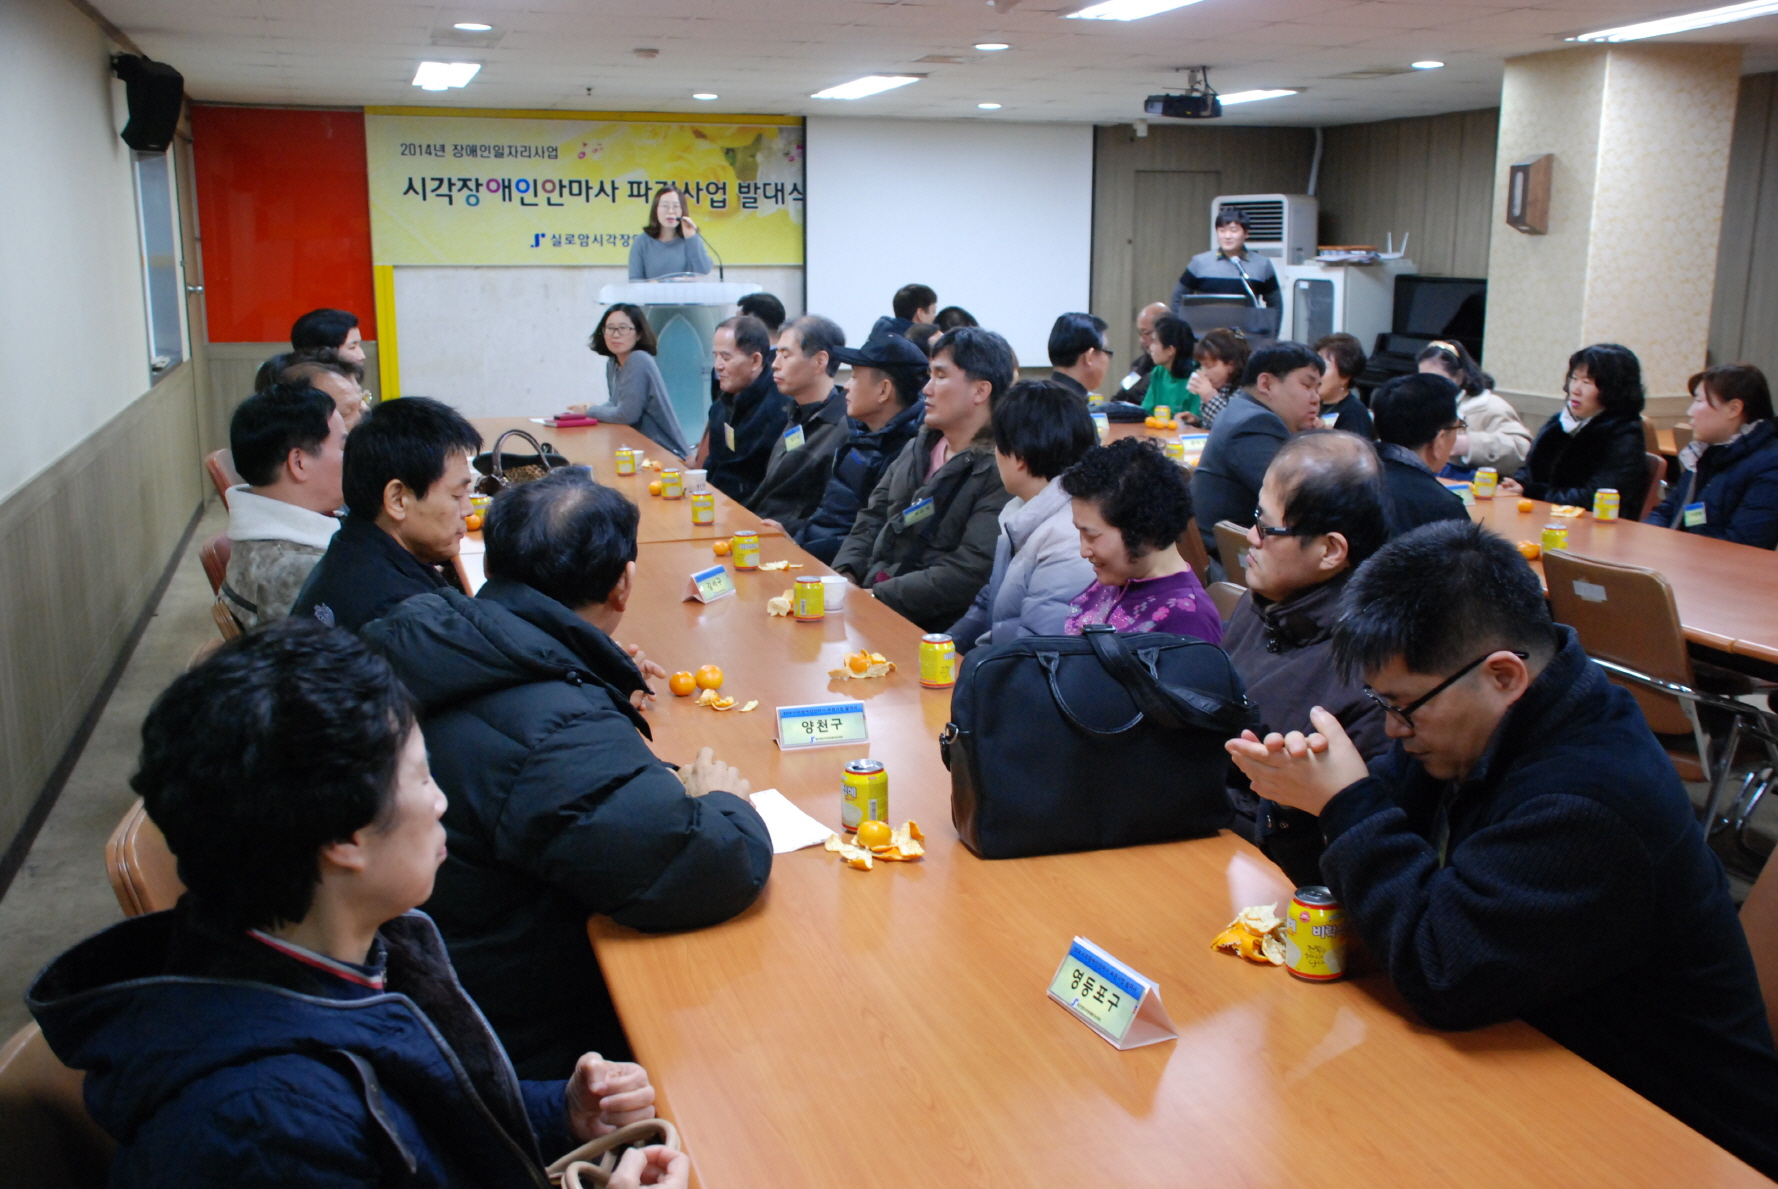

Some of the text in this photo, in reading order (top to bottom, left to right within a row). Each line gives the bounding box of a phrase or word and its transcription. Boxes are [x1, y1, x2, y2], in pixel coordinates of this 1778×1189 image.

[400, 142, 559, 160] 2014년 장애인일자리사업
[402, 176, 620, 207] 시각장애인안마사
[627, 179, 728, 209] 파사업
[801, 718, 843, 734] 양천구
[1071, 968, 1121, 1013] 영등포구
